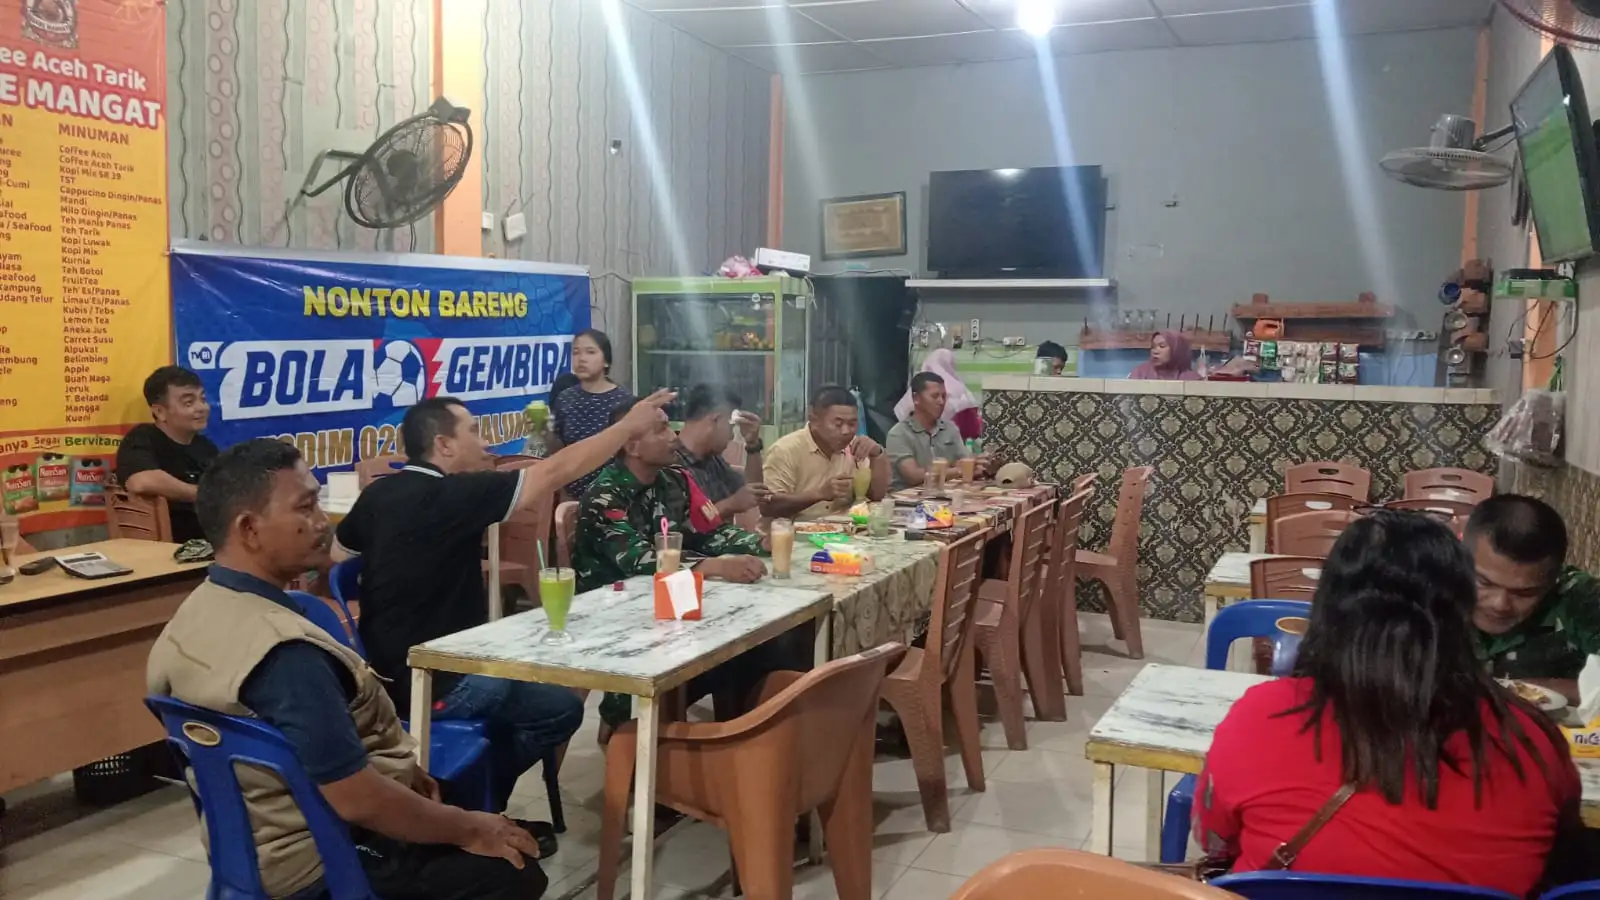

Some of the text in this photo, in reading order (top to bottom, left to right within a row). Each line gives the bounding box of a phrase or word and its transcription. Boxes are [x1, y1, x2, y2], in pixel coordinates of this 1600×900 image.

[32, 52, 88, 79] Aceh
[92, 63, 147, 91] Tarik
[27, 78, 161, 126] MANGAT
[0, 113, 13, 127] N
[58, 123, 130, 145] MINUMAN
[59, 145, 112, 160] Coffee Aceh
[59, 155, 134, 172] Coffee Aceh Tarik
[60, 165, 80, 175] Kopi
[60, 176, 76, 184] TST
[60, 186, 162, 205] Cappucino Dingin/Panas
[60, 196, 87, 205] Mandi
[0, 198, 13, 208] ial
[60, 206, 137, 220] Milo Dingin/Panas
[12, 221, 52, 232] Seafood
[61, 216, 131, 229] Teh Manis Panas
[61, 226, 101, 236] Teh Tarik
[61, 236, 111, 247] Kopi Luwak
[61, 246, 98, 256] Kopi Mix
[0, 252, 22, 263] yam
[61, 256, 91, 265] Kurnia
[62, 266, 104, 275] Teh Botol
[81, 287, 121, 296] Es/Panas
[30, 295, 54, 304] Telur
[303, 285, 529, 318] NONTON BARENG
[63, 306, 88, 314] Kubis
[95, 307, 115, 315] Tebs
[63, 316, 110, 324] Lemon Tea
[63, 326, 91, 334] Aneka
[93, 336, 114, 344] Susu
[64, 345, 98, 354] Alpukat
[64, 355, 108, 364] Belimbing
[64, 365, 90, 374] Apple
[64, 375, 111, 384] Buah Naga
[239, 342, 573, 408] BOLA GEMBIRA
[65, 385, 90, 393] Jeruk
[75, 394, 109, 402] Belanda
[65, 404, 100, 413] Mangga
[64, 434, 121, 447] Bervitam
[258, 427, 354, 468] DIM
